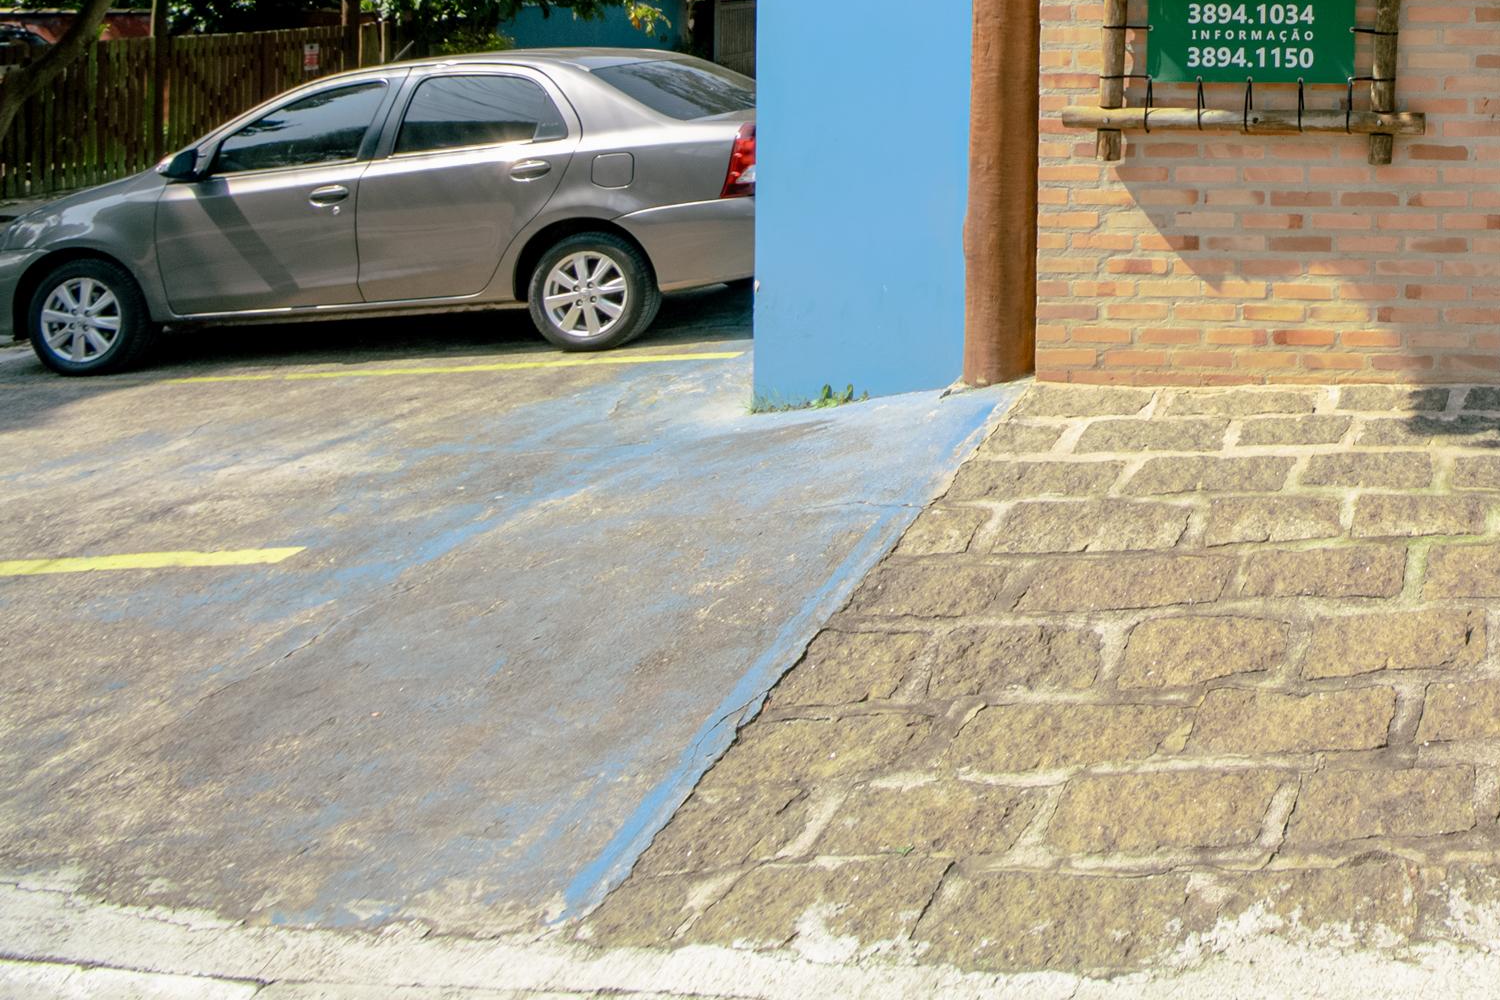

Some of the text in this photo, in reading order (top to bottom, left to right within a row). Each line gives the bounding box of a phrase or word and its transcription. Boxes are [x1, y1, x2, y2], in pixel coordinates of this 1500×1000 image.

[1188, 4, 1314, 25] 3894.1034
[1192, 29, 1314, 42] INFORMAÇÃO
[1187, 47, 1314, 68] 3894.1150
